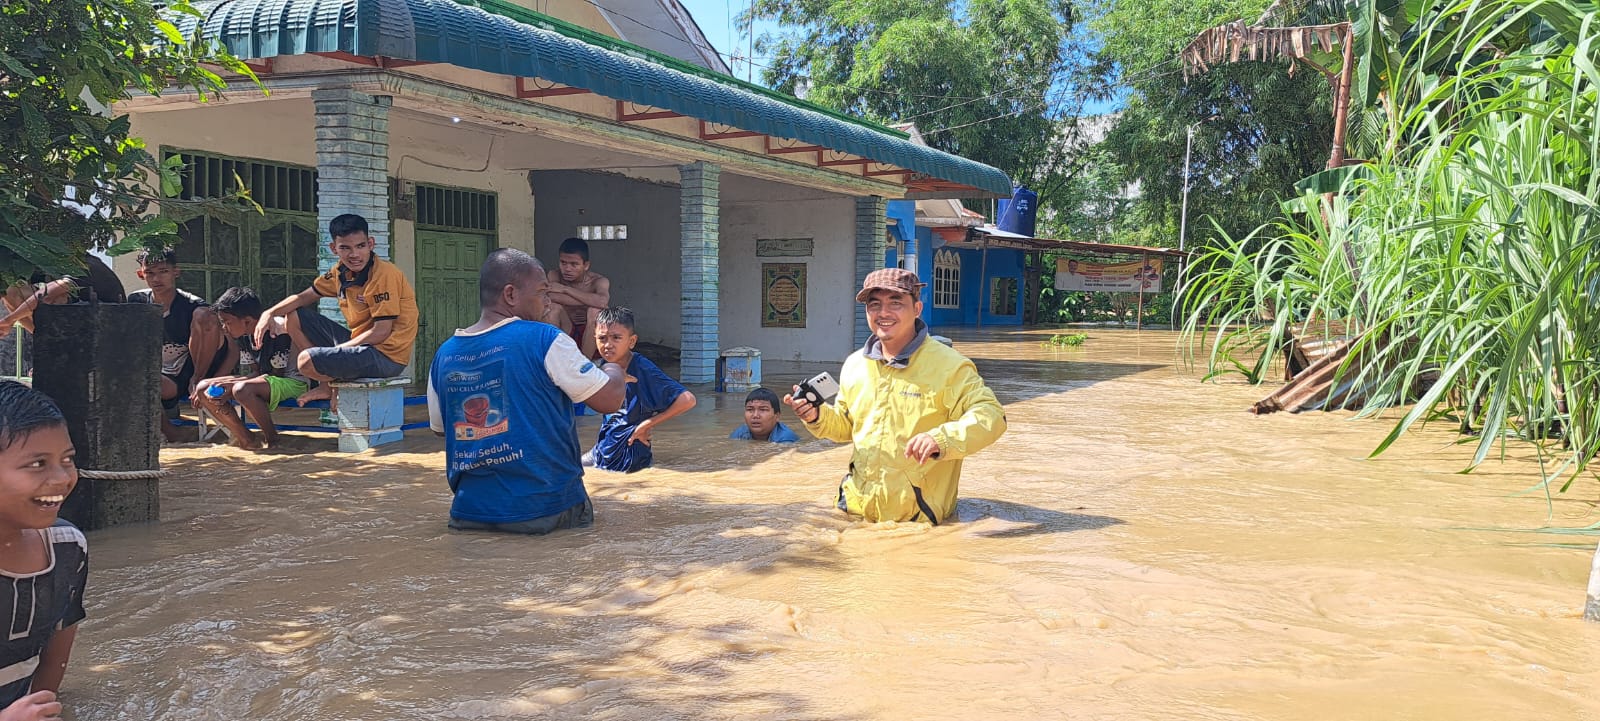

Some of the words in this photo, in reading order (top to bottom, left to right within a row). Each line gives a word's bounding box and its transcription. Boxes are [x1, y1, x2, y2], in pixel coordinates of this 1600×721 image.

[454, 450, 477, 459] Sekali
[478, 442, 513, 458] Seduh,
[486, 449, 524, 467] Penuh!
